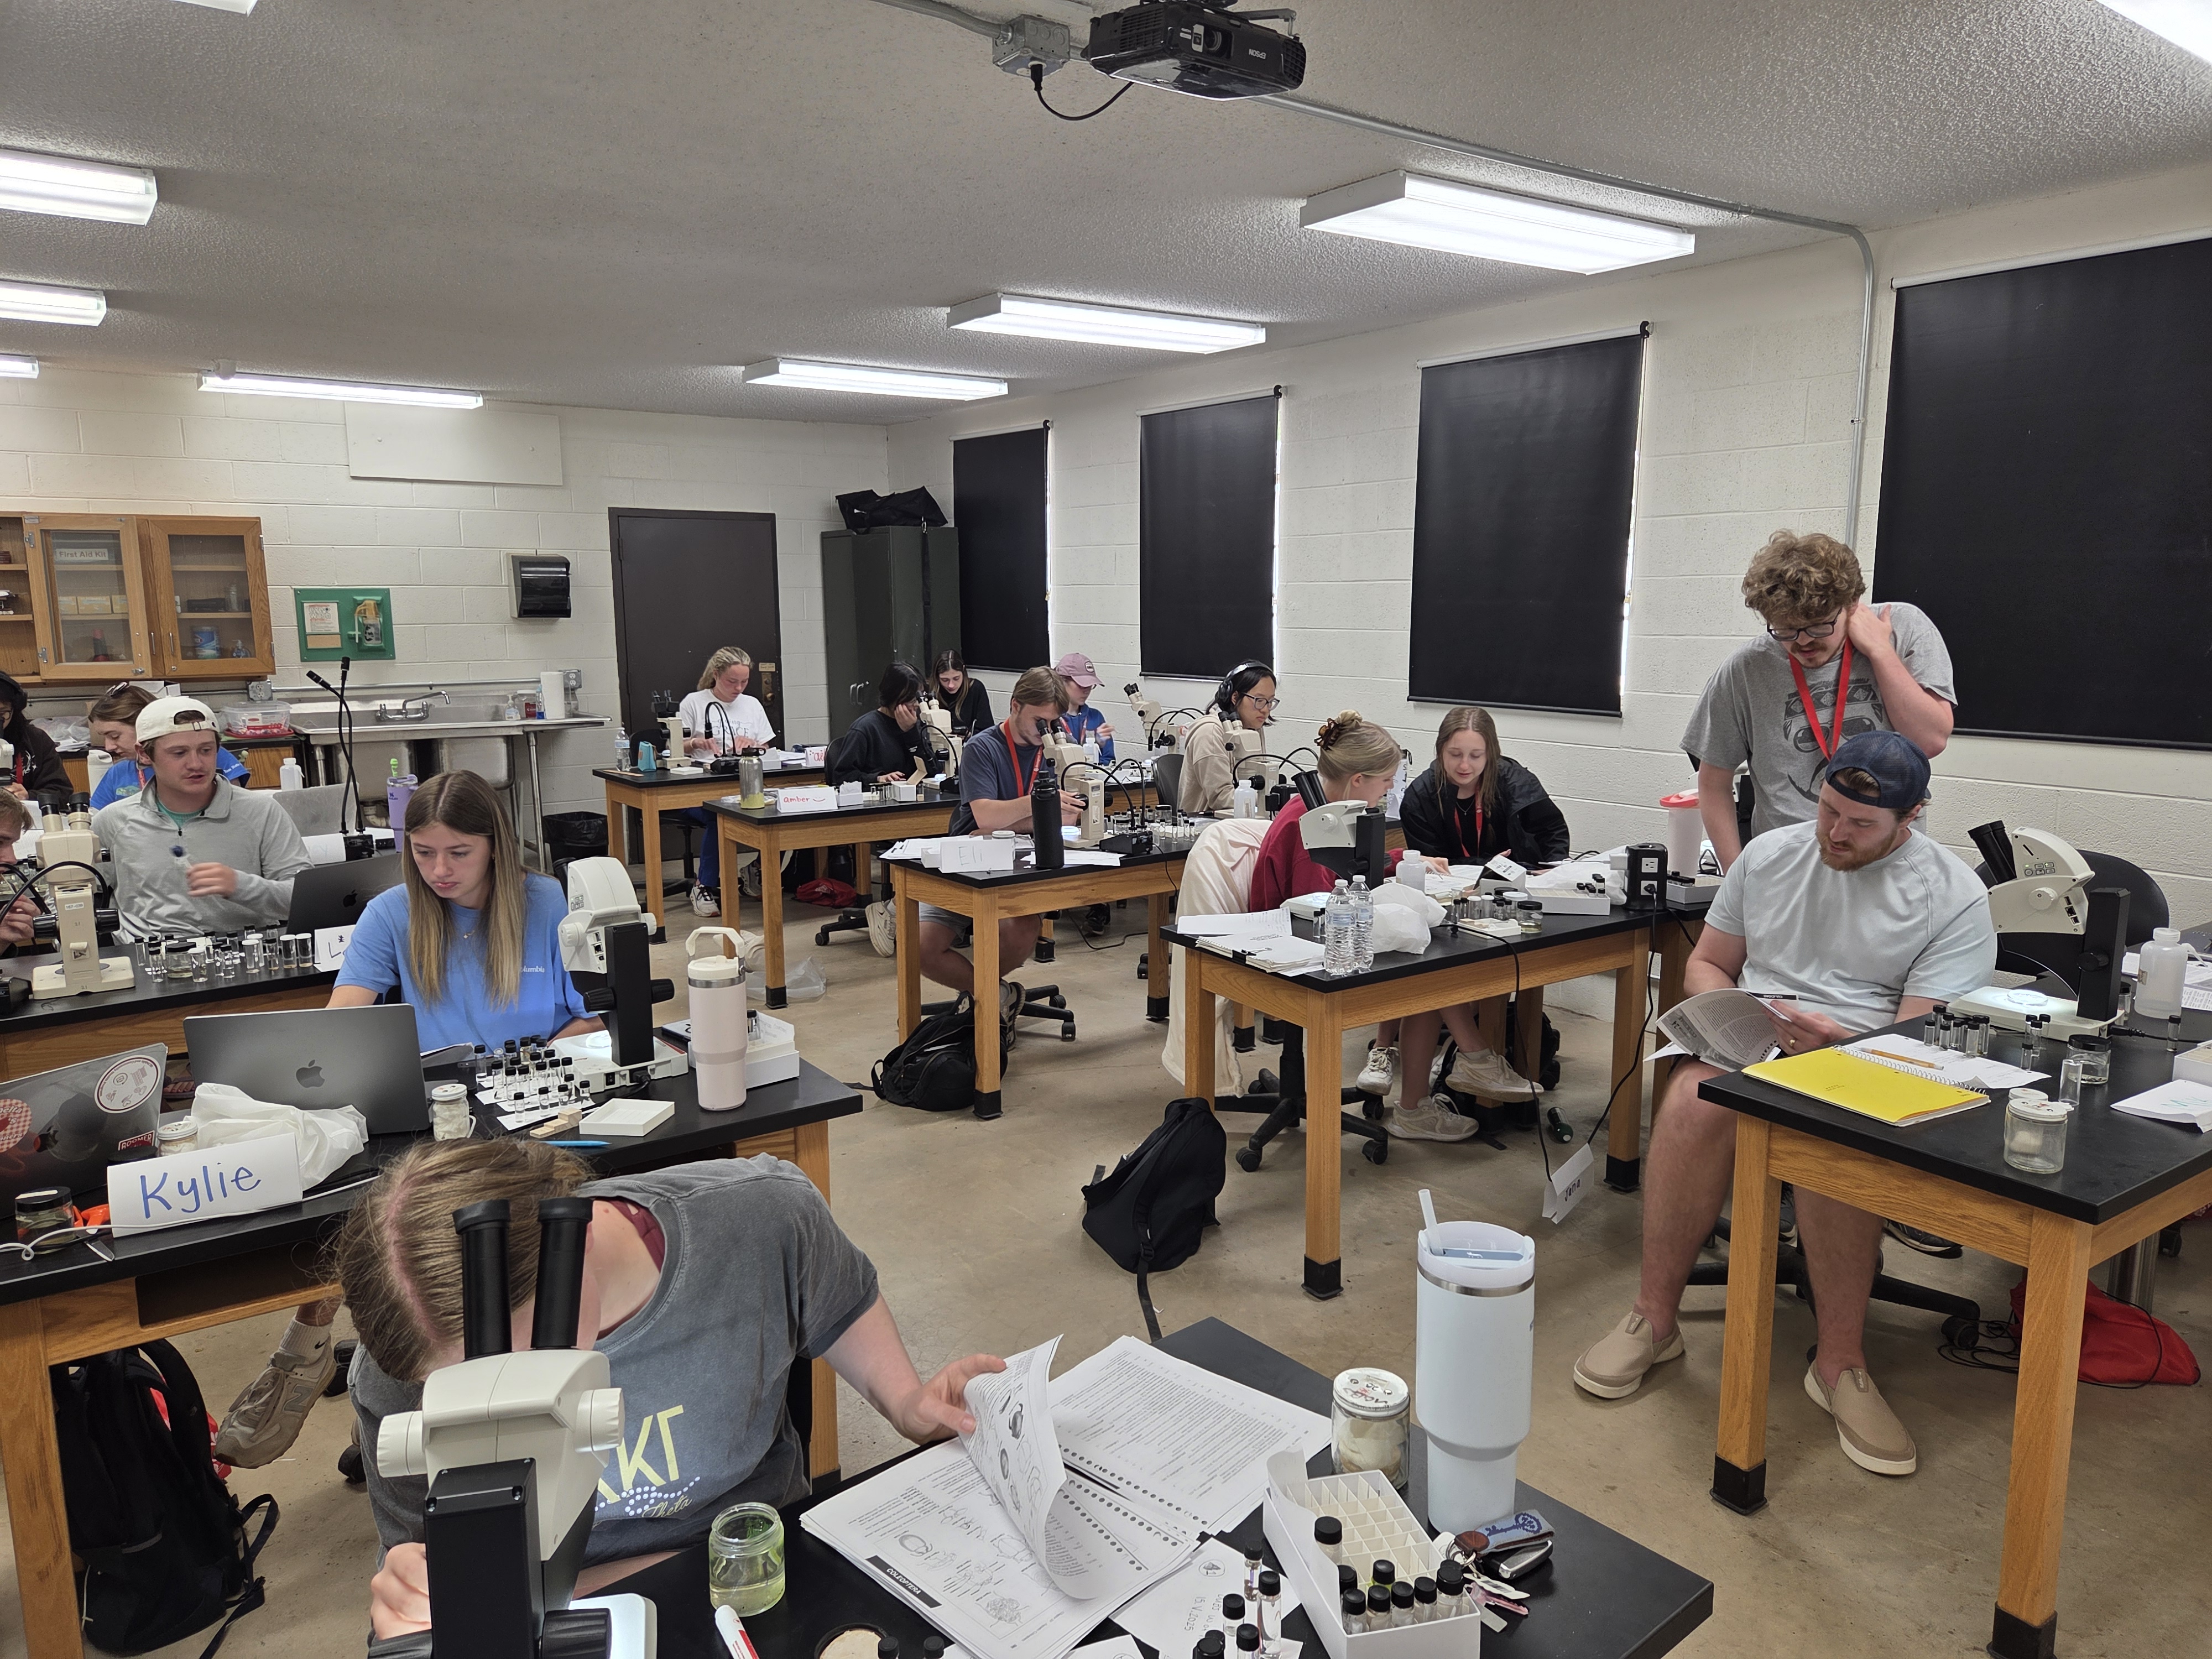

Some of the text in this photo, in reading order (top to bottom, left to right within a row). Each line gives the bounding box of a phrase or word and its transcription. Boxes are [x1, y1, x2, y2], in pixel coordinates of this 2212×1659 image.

[1249, 49, 1266, 59] EPSON
[958, 845, 982, 867] Eli
[140, 1162, 262, 1219] Kylie
[641, 1494, 693, 1517] Theta
[886, 1568, 921, 1594] COLEOPTERA
